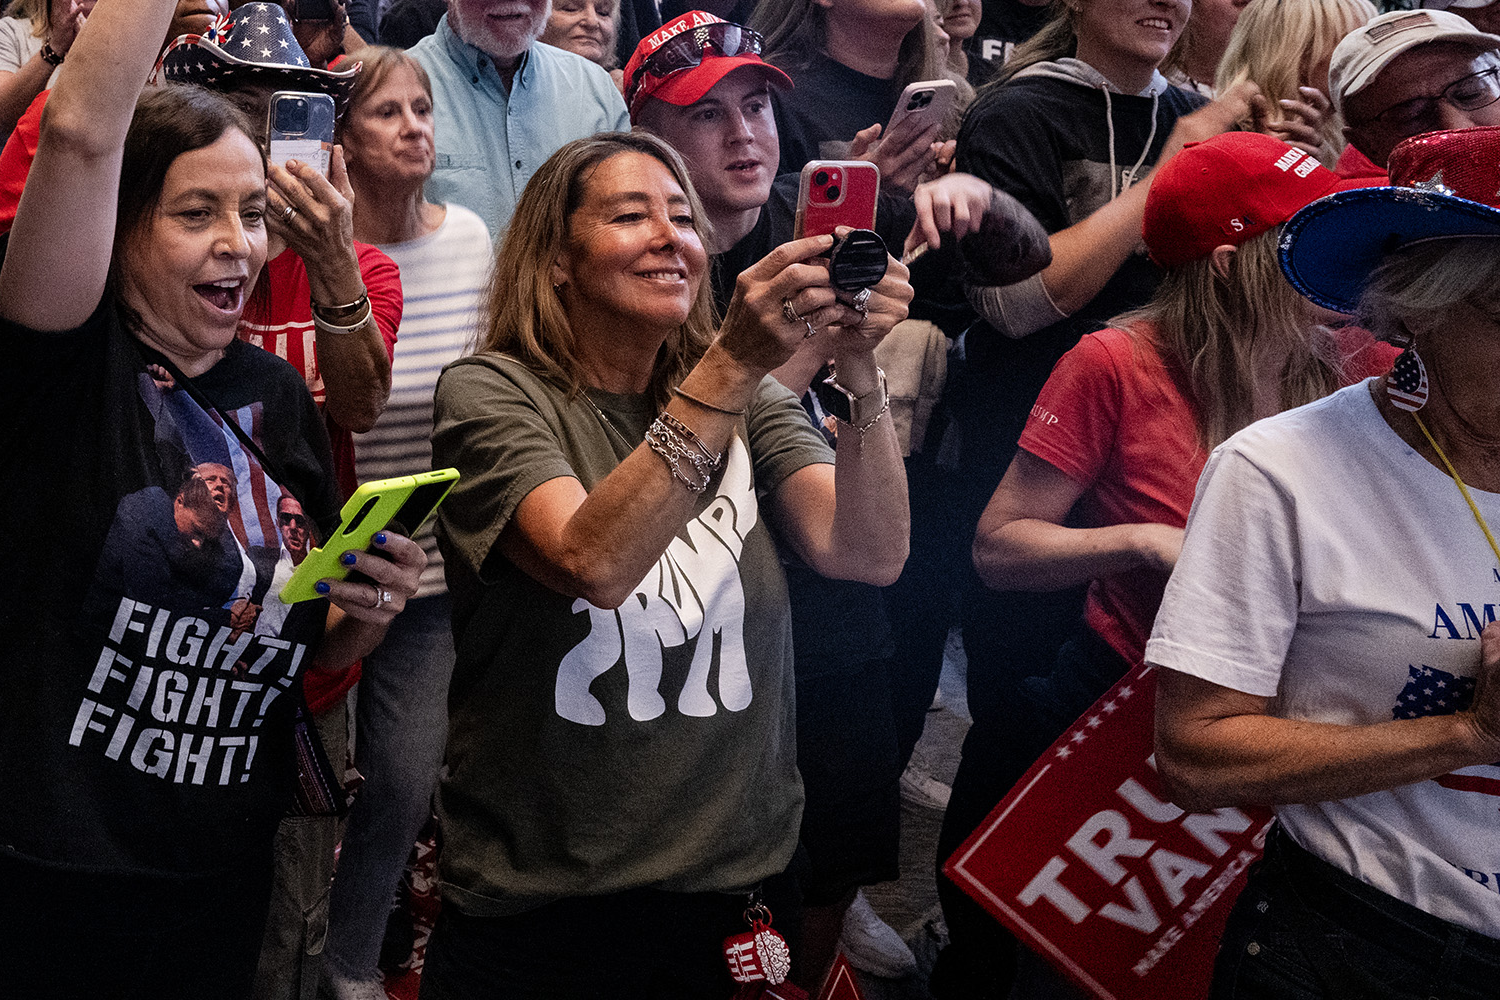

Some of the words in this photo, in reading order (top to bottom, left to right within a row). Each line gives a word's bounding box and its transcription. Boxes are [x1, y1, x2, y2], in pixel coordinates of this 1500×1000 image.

[647, 20, 690, 50] MAKE
[108, 596, 307, 688] FIGHT!
[87, 645, 283, 728] FIGHT!
[68, 697, 259, 786] FIGHT!
